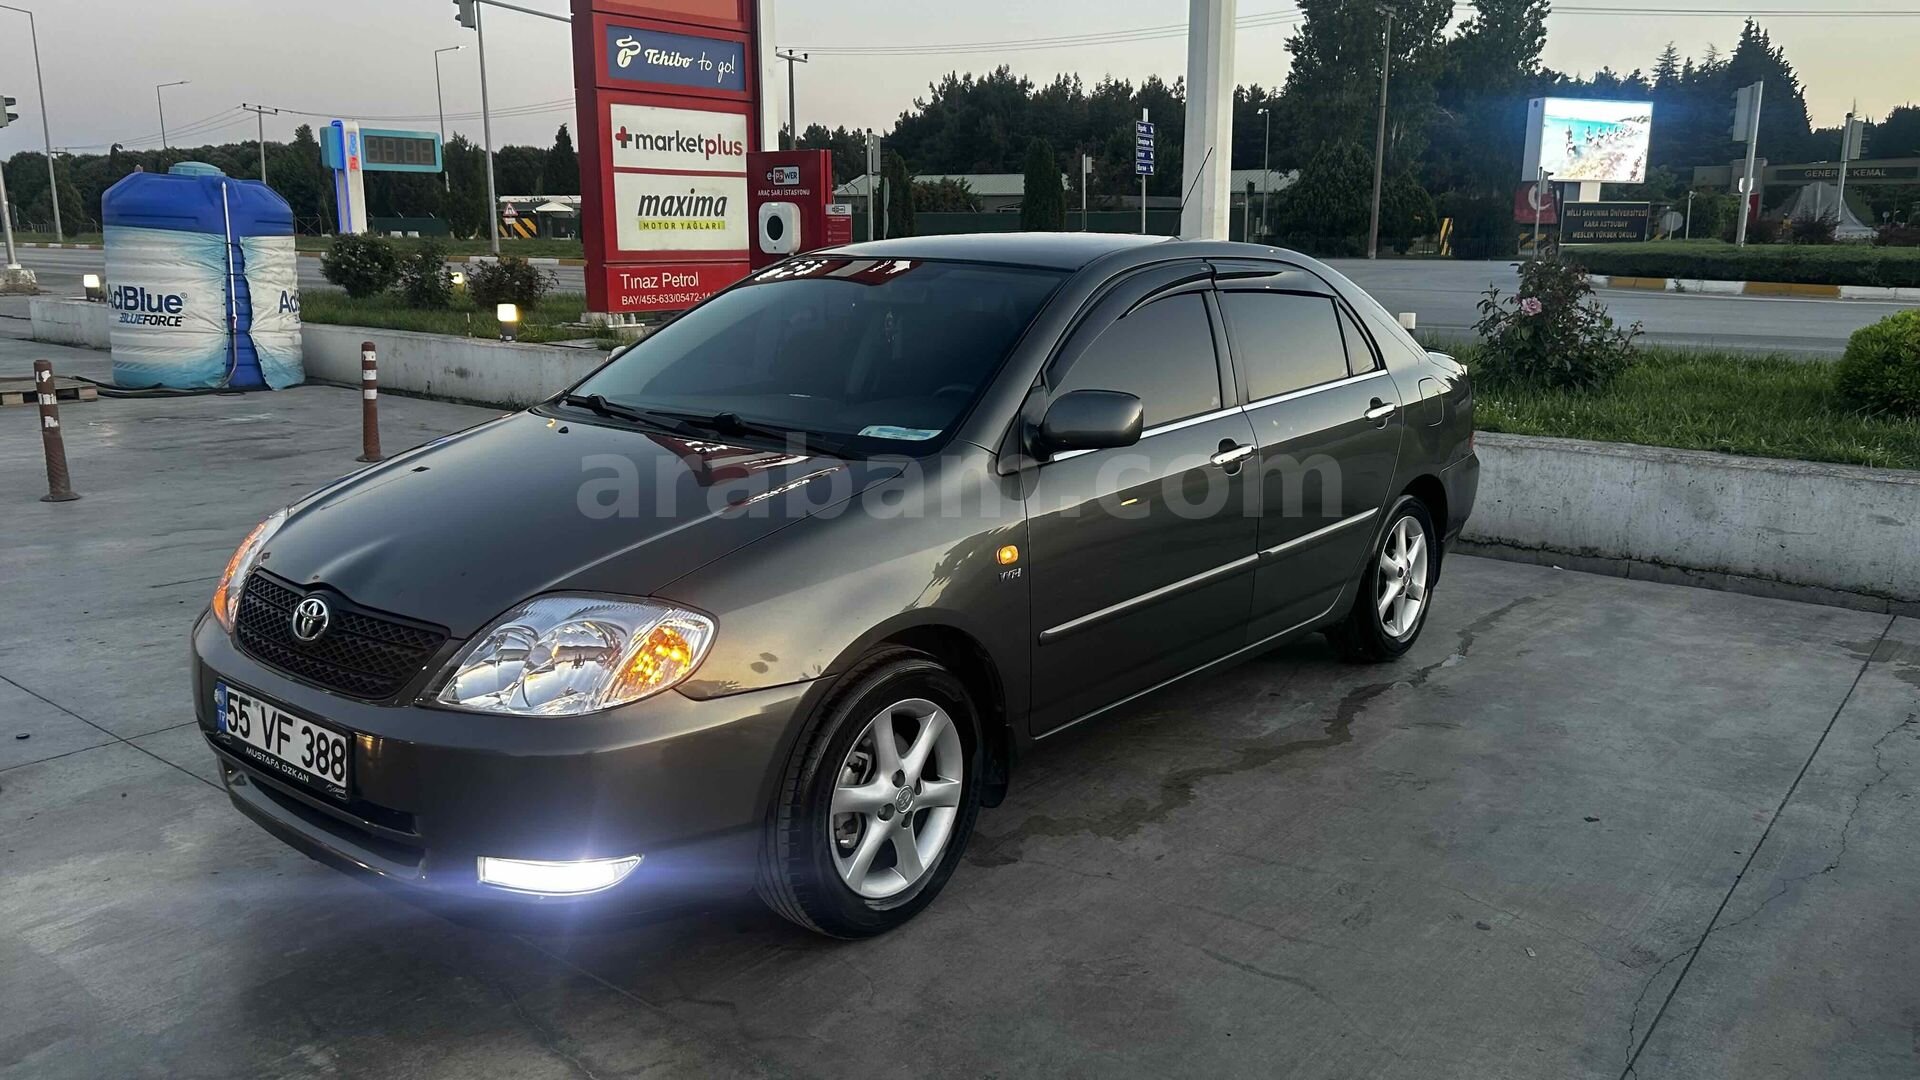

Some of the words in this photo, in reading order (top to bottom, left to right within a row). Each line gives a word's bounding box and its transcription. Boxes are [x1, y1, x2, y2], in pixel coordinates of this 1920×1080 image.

[645, 48, 693, 68] Tchibo
[698, 51, 712, 71] to
[717, 54, 735, 83] go!
[635, 130, 743, 160] marketplus
[1804, 169, 1850, 177] GENERL
[1853, 168, 1887, 176] KEMAL
[638, 188, 728, 217] maxima
[680, 221, 721, 230] YAĞLARI
[620, 273, 658, 290] Tınaz
[662, 271, 699, 287] Petrol
[621, 291, 717, 306] BAY/455-633/05472-14
[119, 314, 182, 327] BLUEFORCE
[217, 709, 226, 722] TR
[227, 692, 251, 739] 55
[261, 706, 294, 755] VF
[301, 726, 345, 782] 388
[246, 747, 280, 768] MUSTAFA
[281, 764, 310, 783] ÖZKAN
